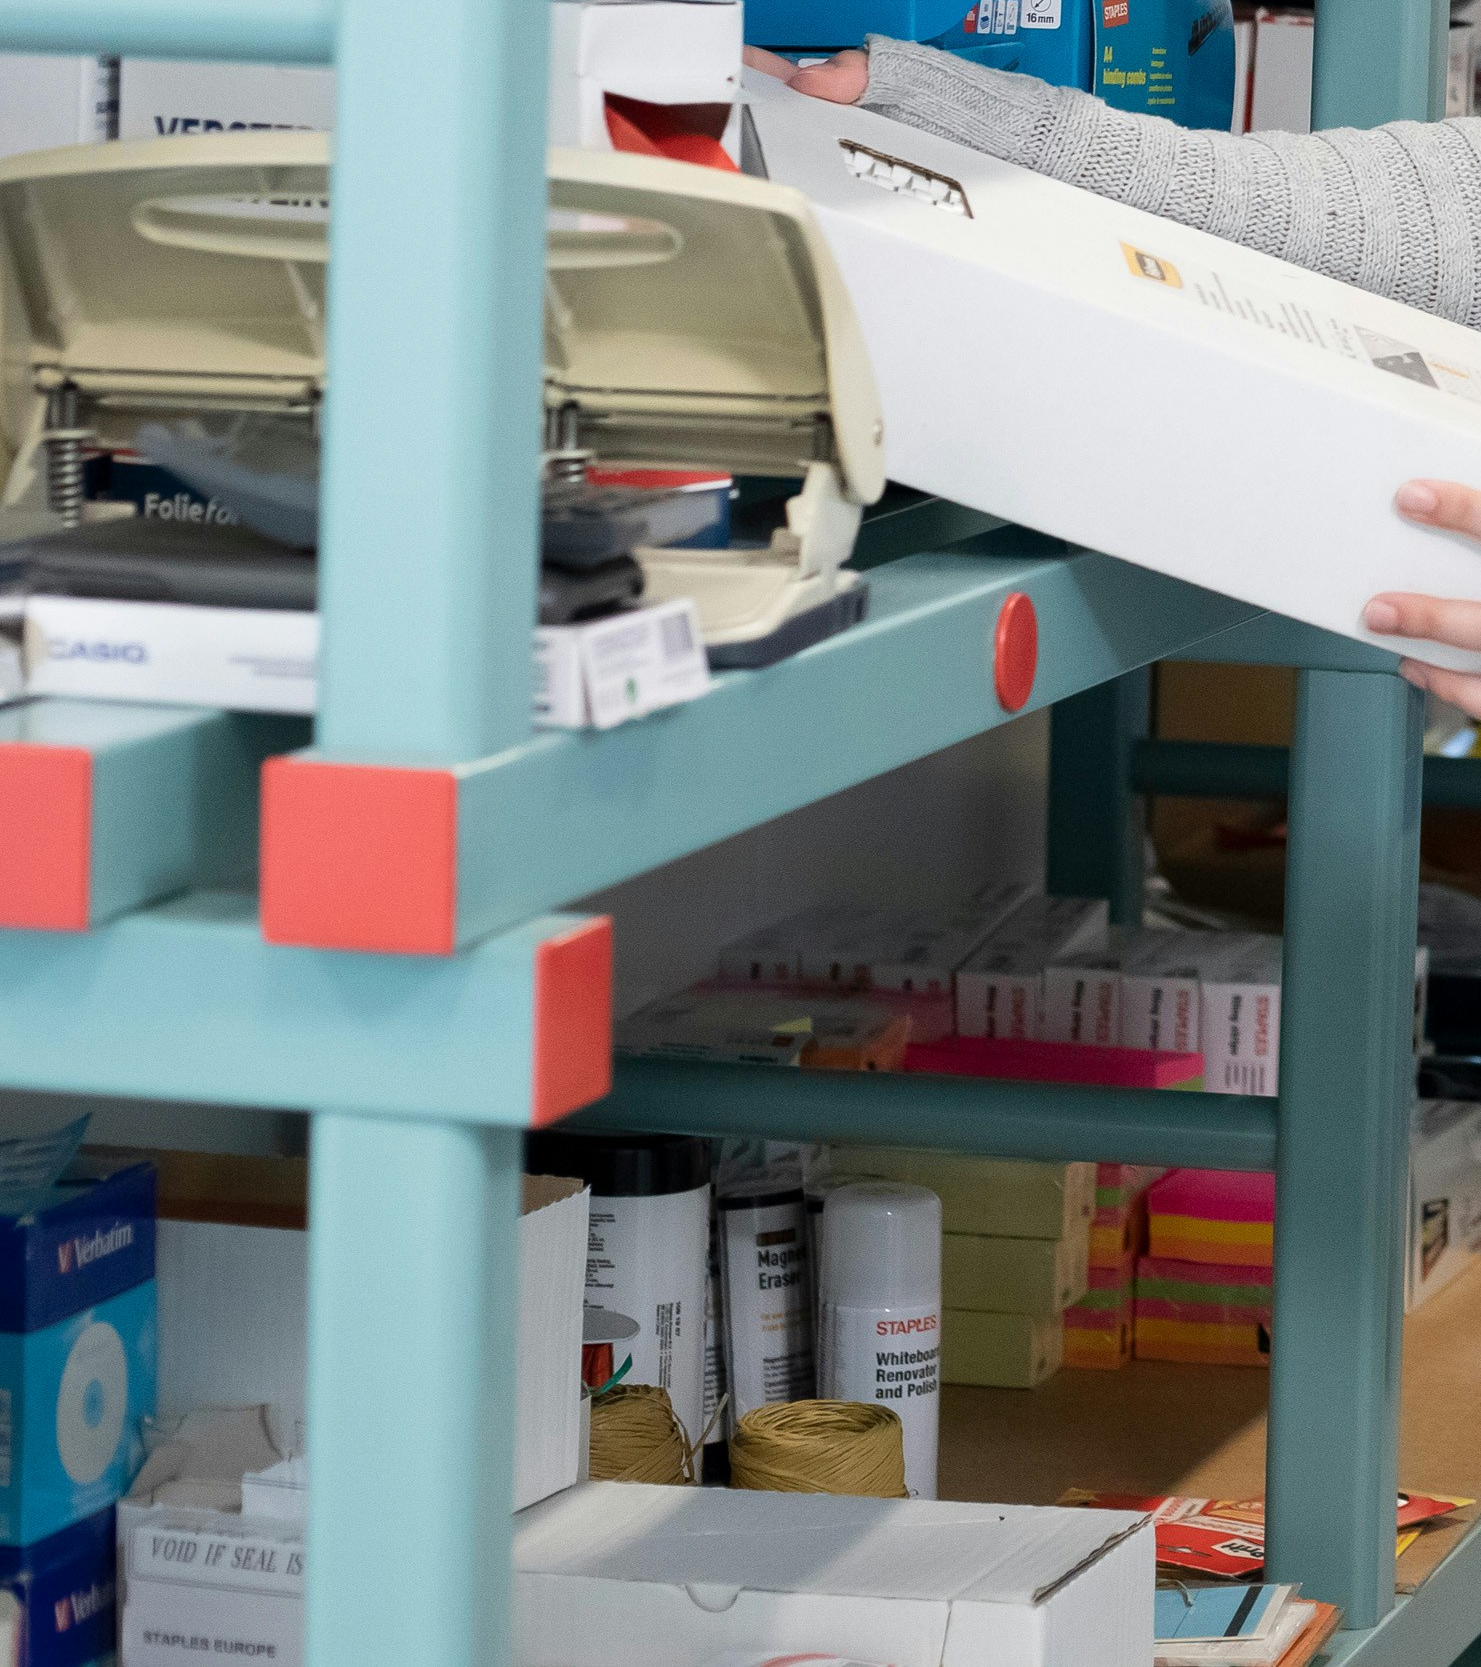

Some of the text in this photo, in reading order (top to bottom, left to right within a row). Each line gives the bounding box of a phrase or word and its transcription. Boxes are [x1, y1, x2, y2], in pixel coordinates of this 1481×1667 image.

[1104, 1, 1128, 20] STAPLES
[74, 1220, 133, 1269] Verbatim
[876, 1314, 937, 1336] STAPLES
[876, 1364, 937, 1383] Renovator
[875, 1377, 938, 1400] and Polish
[152, 1536, 198, 1564] VOID
[205, 1543, 227, 1566] IF
[231, 1546, 277, 1574] SEAL
[143, 1630, 277, 1659] STAPLES EUROPE
